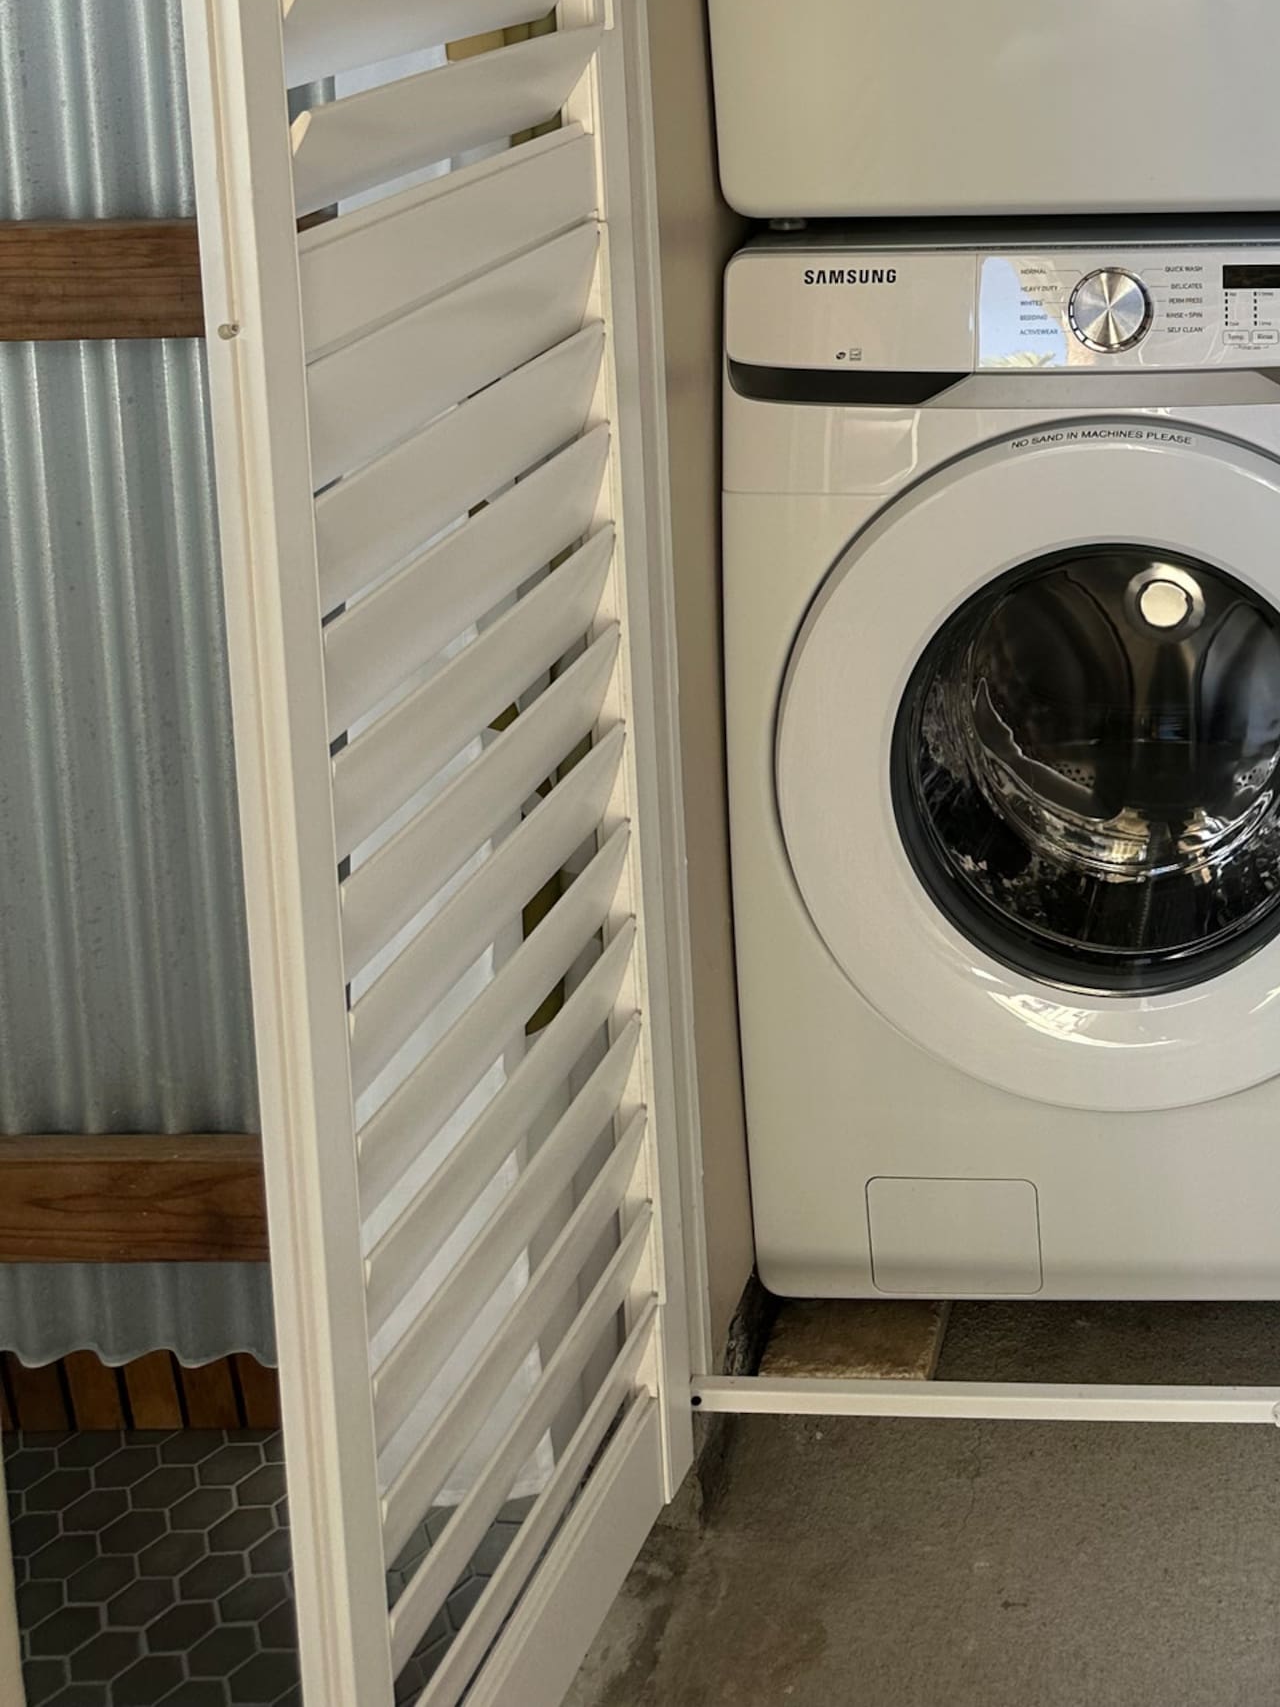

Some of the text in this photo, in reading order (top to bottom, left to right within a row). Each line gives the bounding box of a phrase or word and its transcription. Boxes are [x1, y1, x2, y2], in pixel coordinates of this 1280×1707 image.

[803, 269, 897, 285] SAMSUNG
[1170, 282, 1203, 290] DELICATES
[1011, 429, 1193, 449] NO SAND IN MACHINES PLEASE
